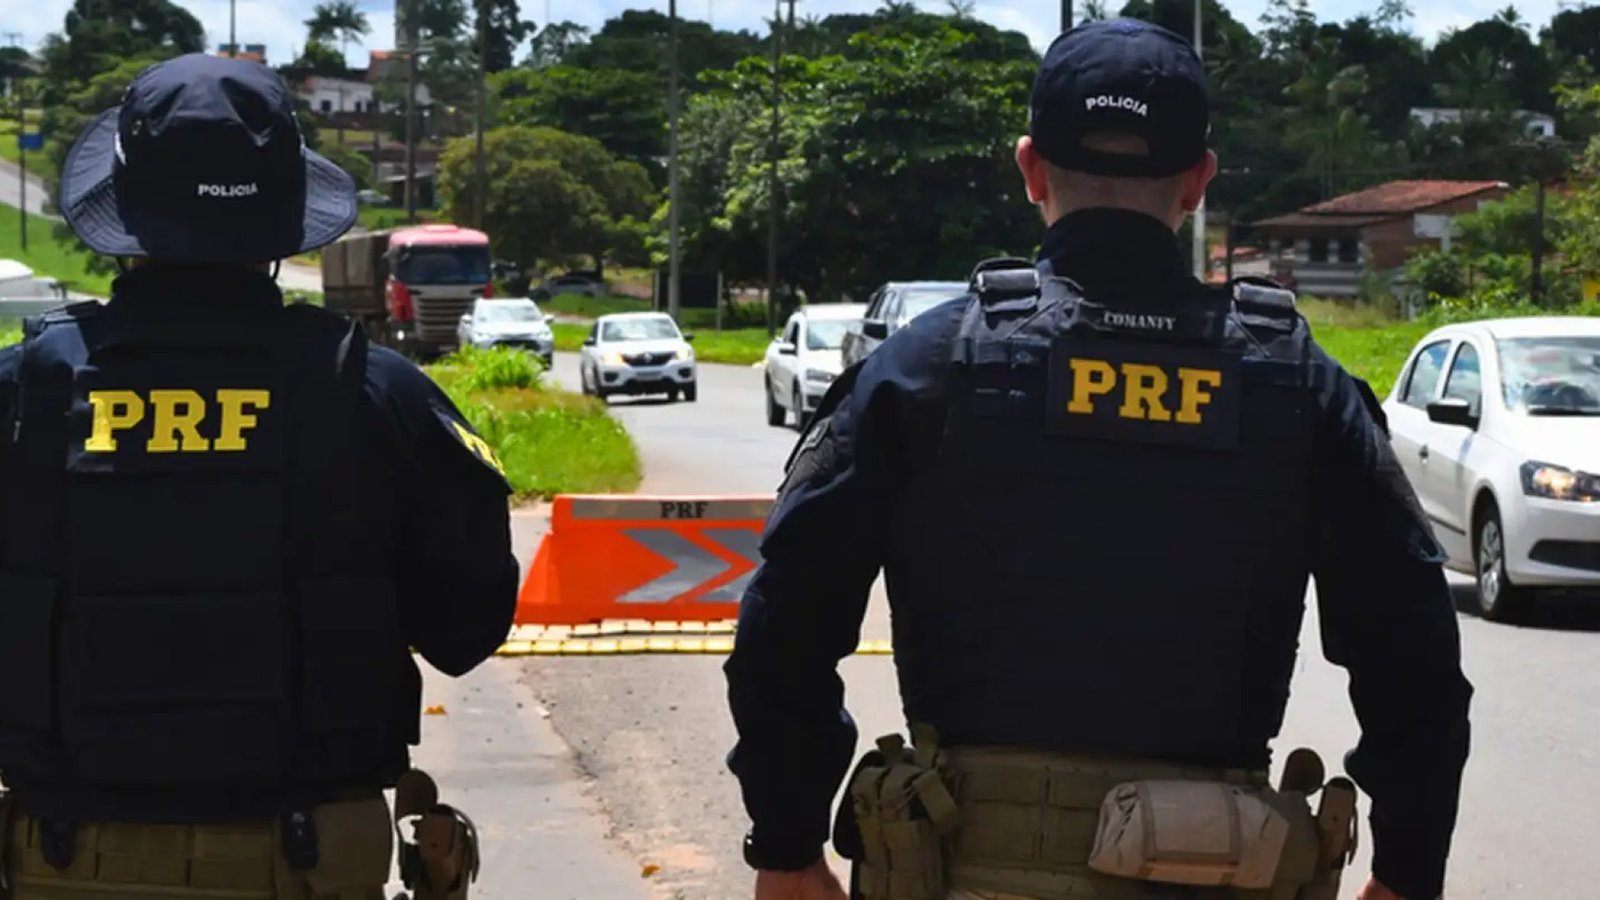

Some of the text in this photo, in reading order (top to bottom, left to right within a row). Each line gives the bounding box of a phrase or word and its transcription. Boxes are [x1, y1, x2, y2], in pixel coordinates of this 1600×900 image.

[84, 389, 270, 452] PRF
[1067, 357, 1222, 424] PRF
[660, 500, 708, 519] PRF
